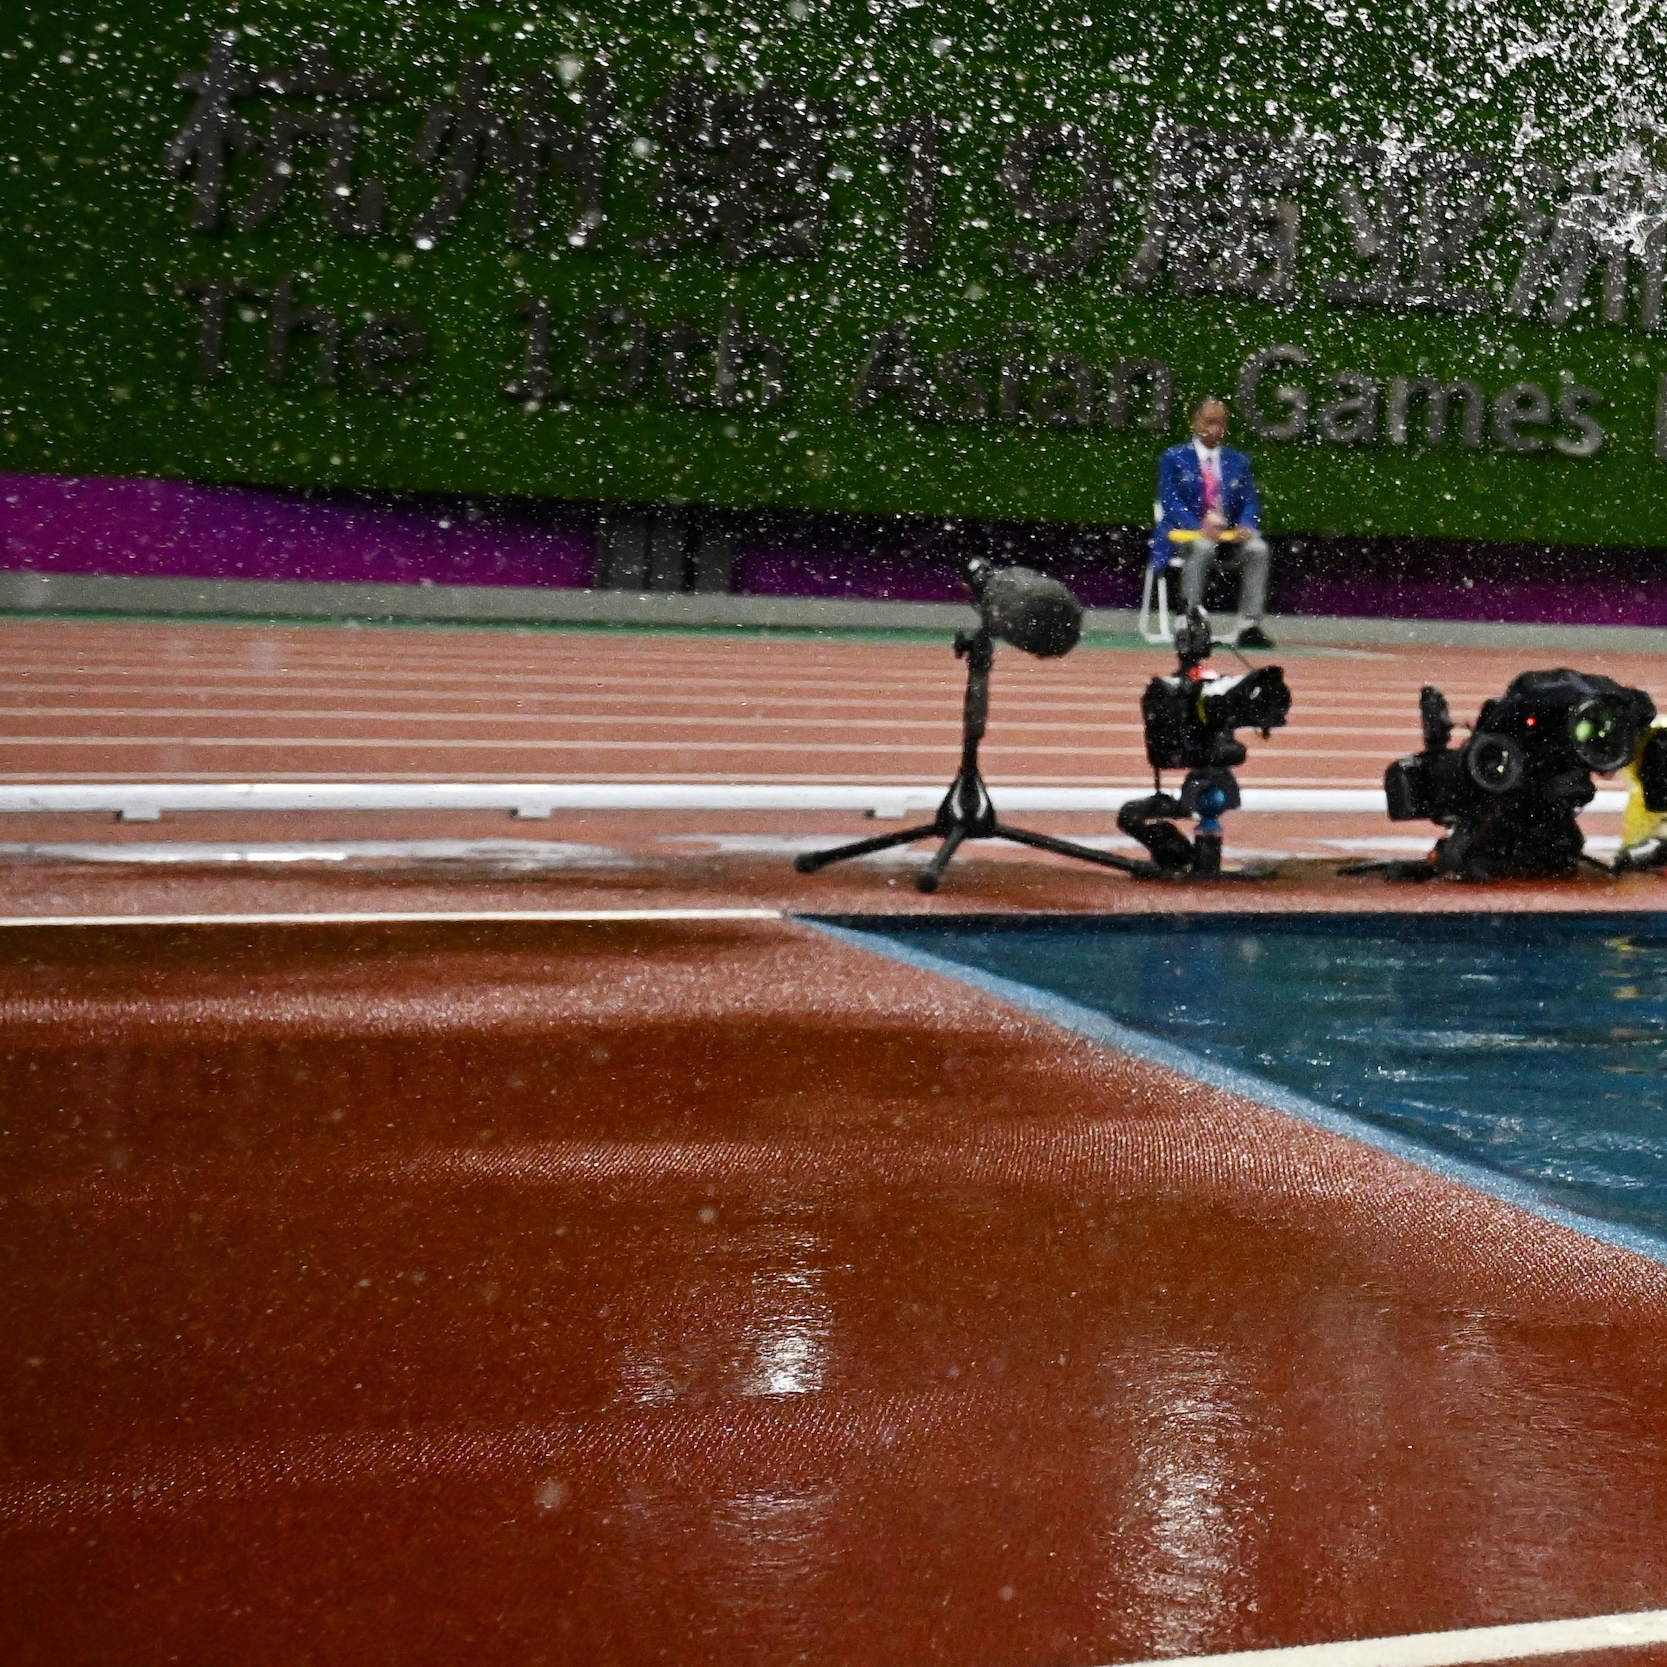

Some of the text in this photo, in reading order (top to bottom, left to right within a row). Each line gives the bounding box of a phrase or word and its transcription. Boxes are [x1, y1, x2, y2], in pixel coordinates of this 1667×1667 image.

[177, 279, 431, 395] The
[504, 297, 789, 413] 19th
[851, 318, 1175, 434] Asian
[1232, 341, 1606, 457] Games
